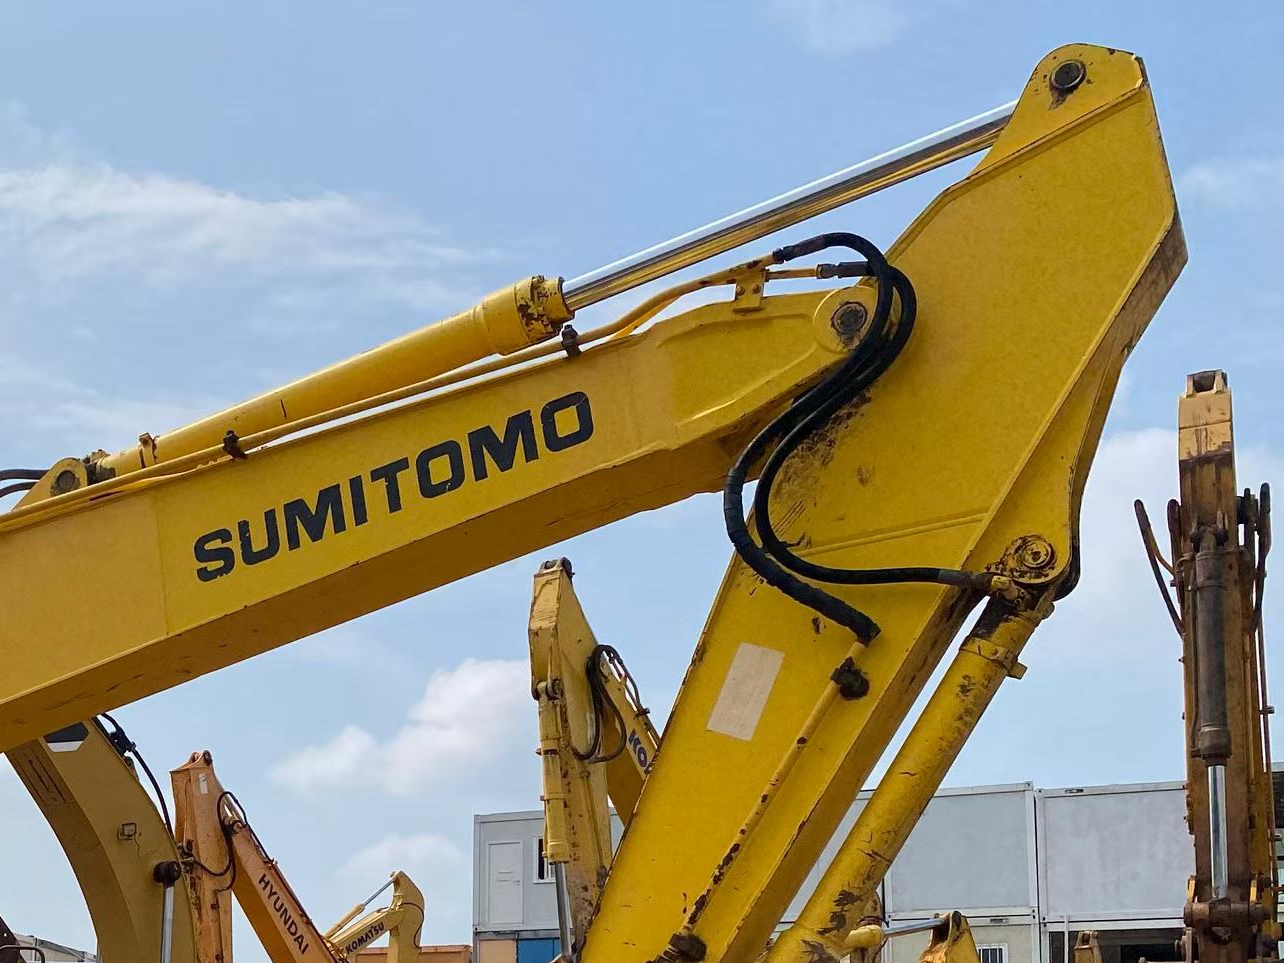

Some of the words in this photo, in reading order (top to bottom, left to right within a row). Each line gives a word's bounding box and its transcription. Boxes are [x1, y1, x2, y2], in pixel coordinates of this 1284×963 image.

[193, 391, 595, 583] SUMITOMO
[258, 873, 310, 955] HYUNDAI
[345, 922, 385, 955] KOMATSU
